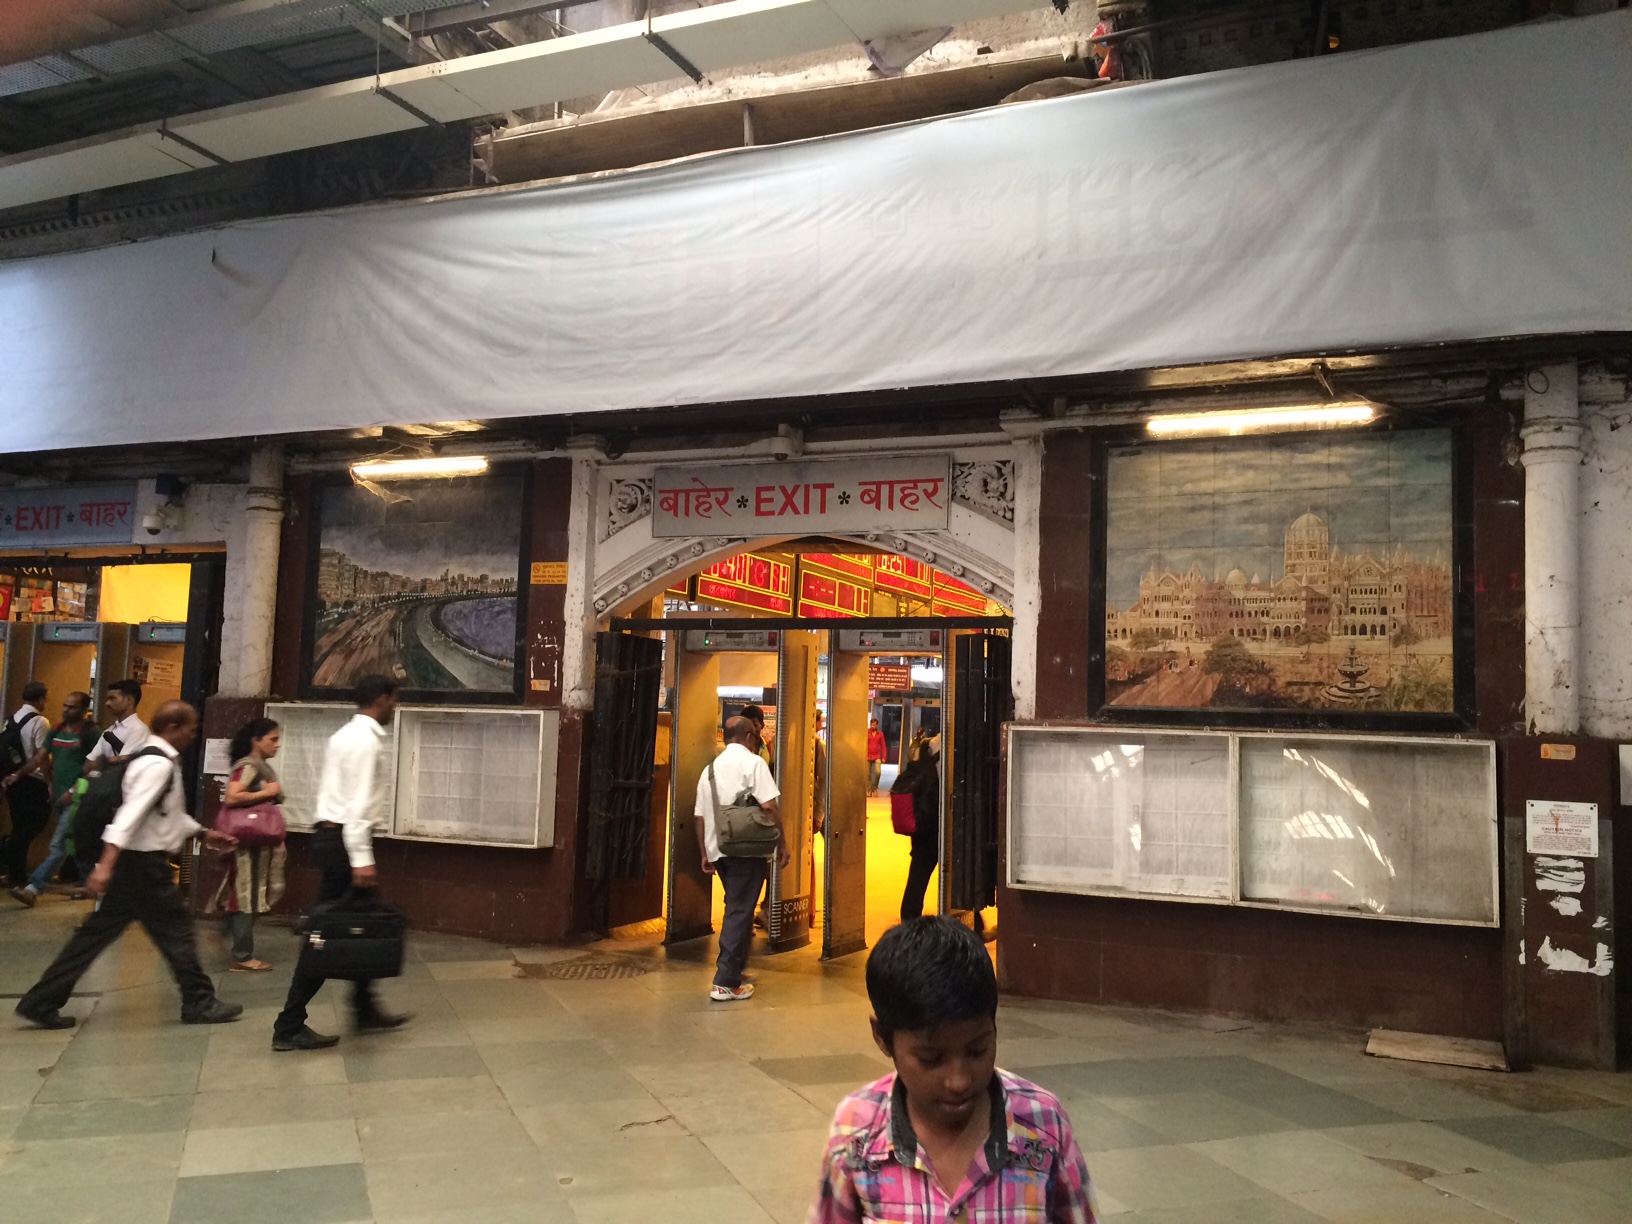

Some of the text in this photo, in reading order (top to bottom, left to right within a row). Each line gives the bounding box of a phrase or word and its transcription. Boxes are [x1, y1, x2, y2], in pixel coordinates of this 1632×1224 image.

[657, 478, 945, 518] बाहेर EXIT बाहर
[15, 505, 65, 531] EXIT
[79, 501, 131, 527] बाहर
[783, 898, 809, 914] SCANNER
